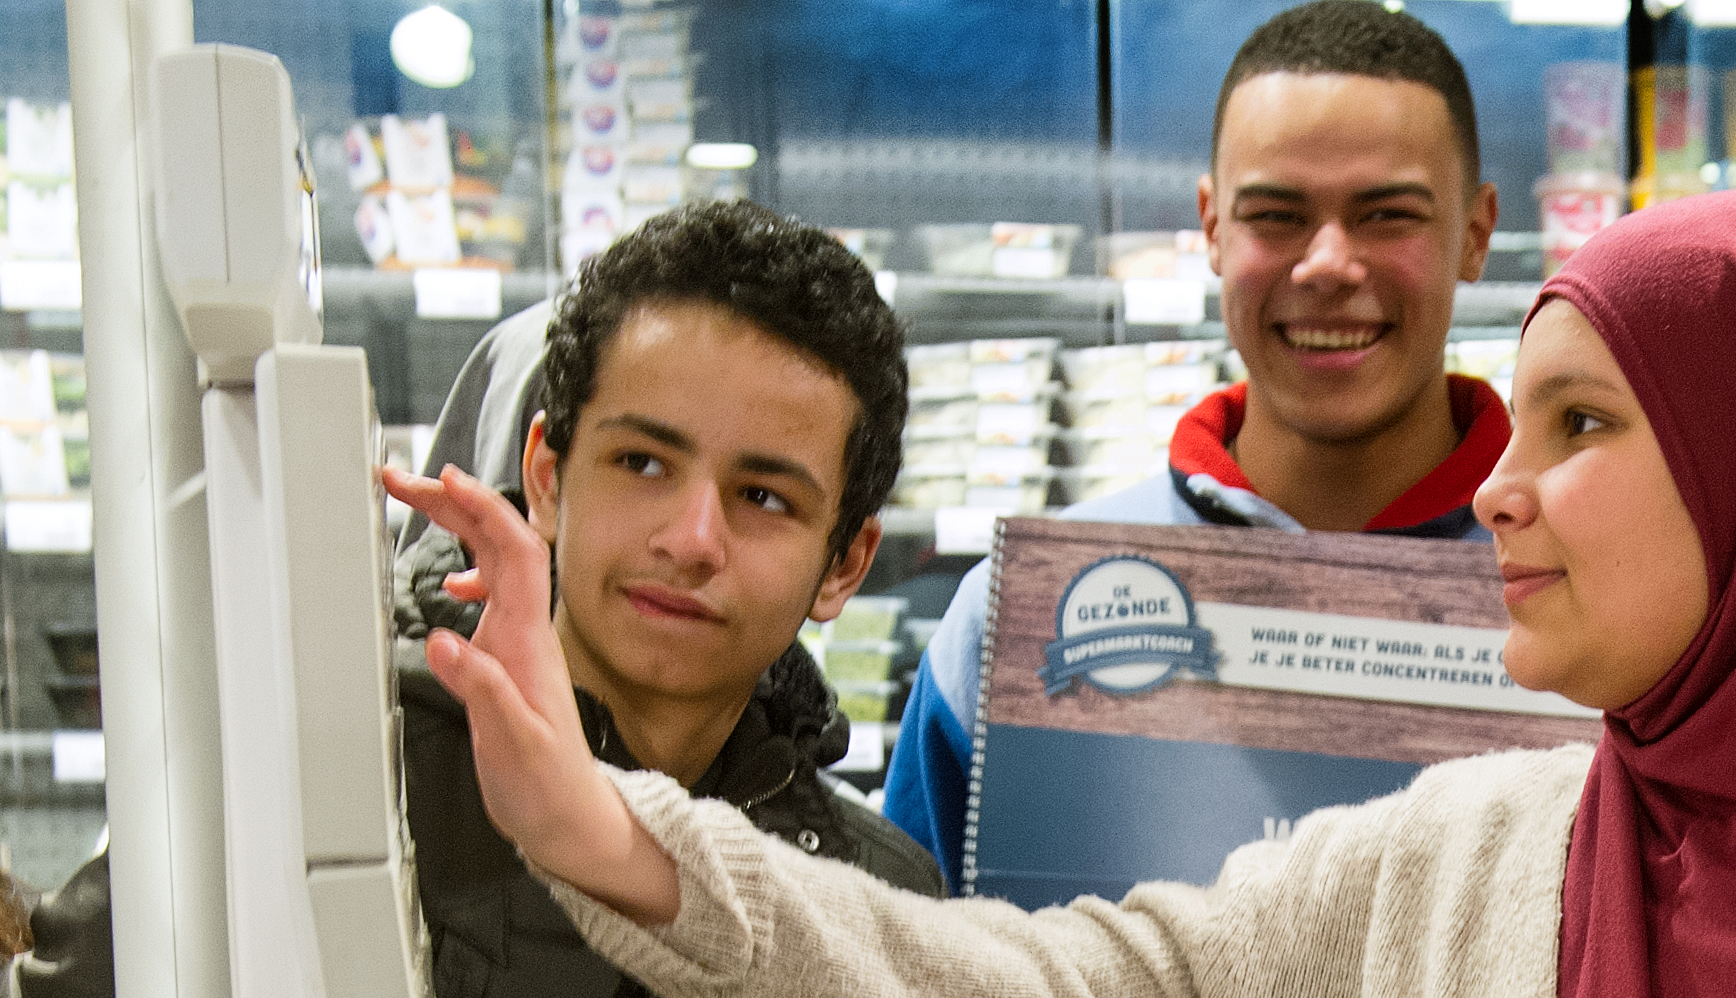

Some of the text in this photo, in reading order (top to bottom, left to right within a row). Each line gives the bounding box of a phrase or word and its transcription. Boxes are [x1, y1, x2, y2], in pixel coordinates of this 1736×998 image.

[1113, 585, 1132, 598] DE
[1063, 633, 1193, 665] SUPERMARKTCOACH
[1251, 627, 1298, 645] WAAR
[1304, 632, 1324, 647] OF
[1331, 635, 1370, 651] NIET
[1434, 643, 1465, 661] ALS
[1472, 648, 1492, 664] JE
[1250, 650, 1269, 665] JE
[1275, 652, 1296, 668] JE
[1302, 655, 1355, 672] BETER
[1361, 660, 1493, 687] CONCENTREREN
